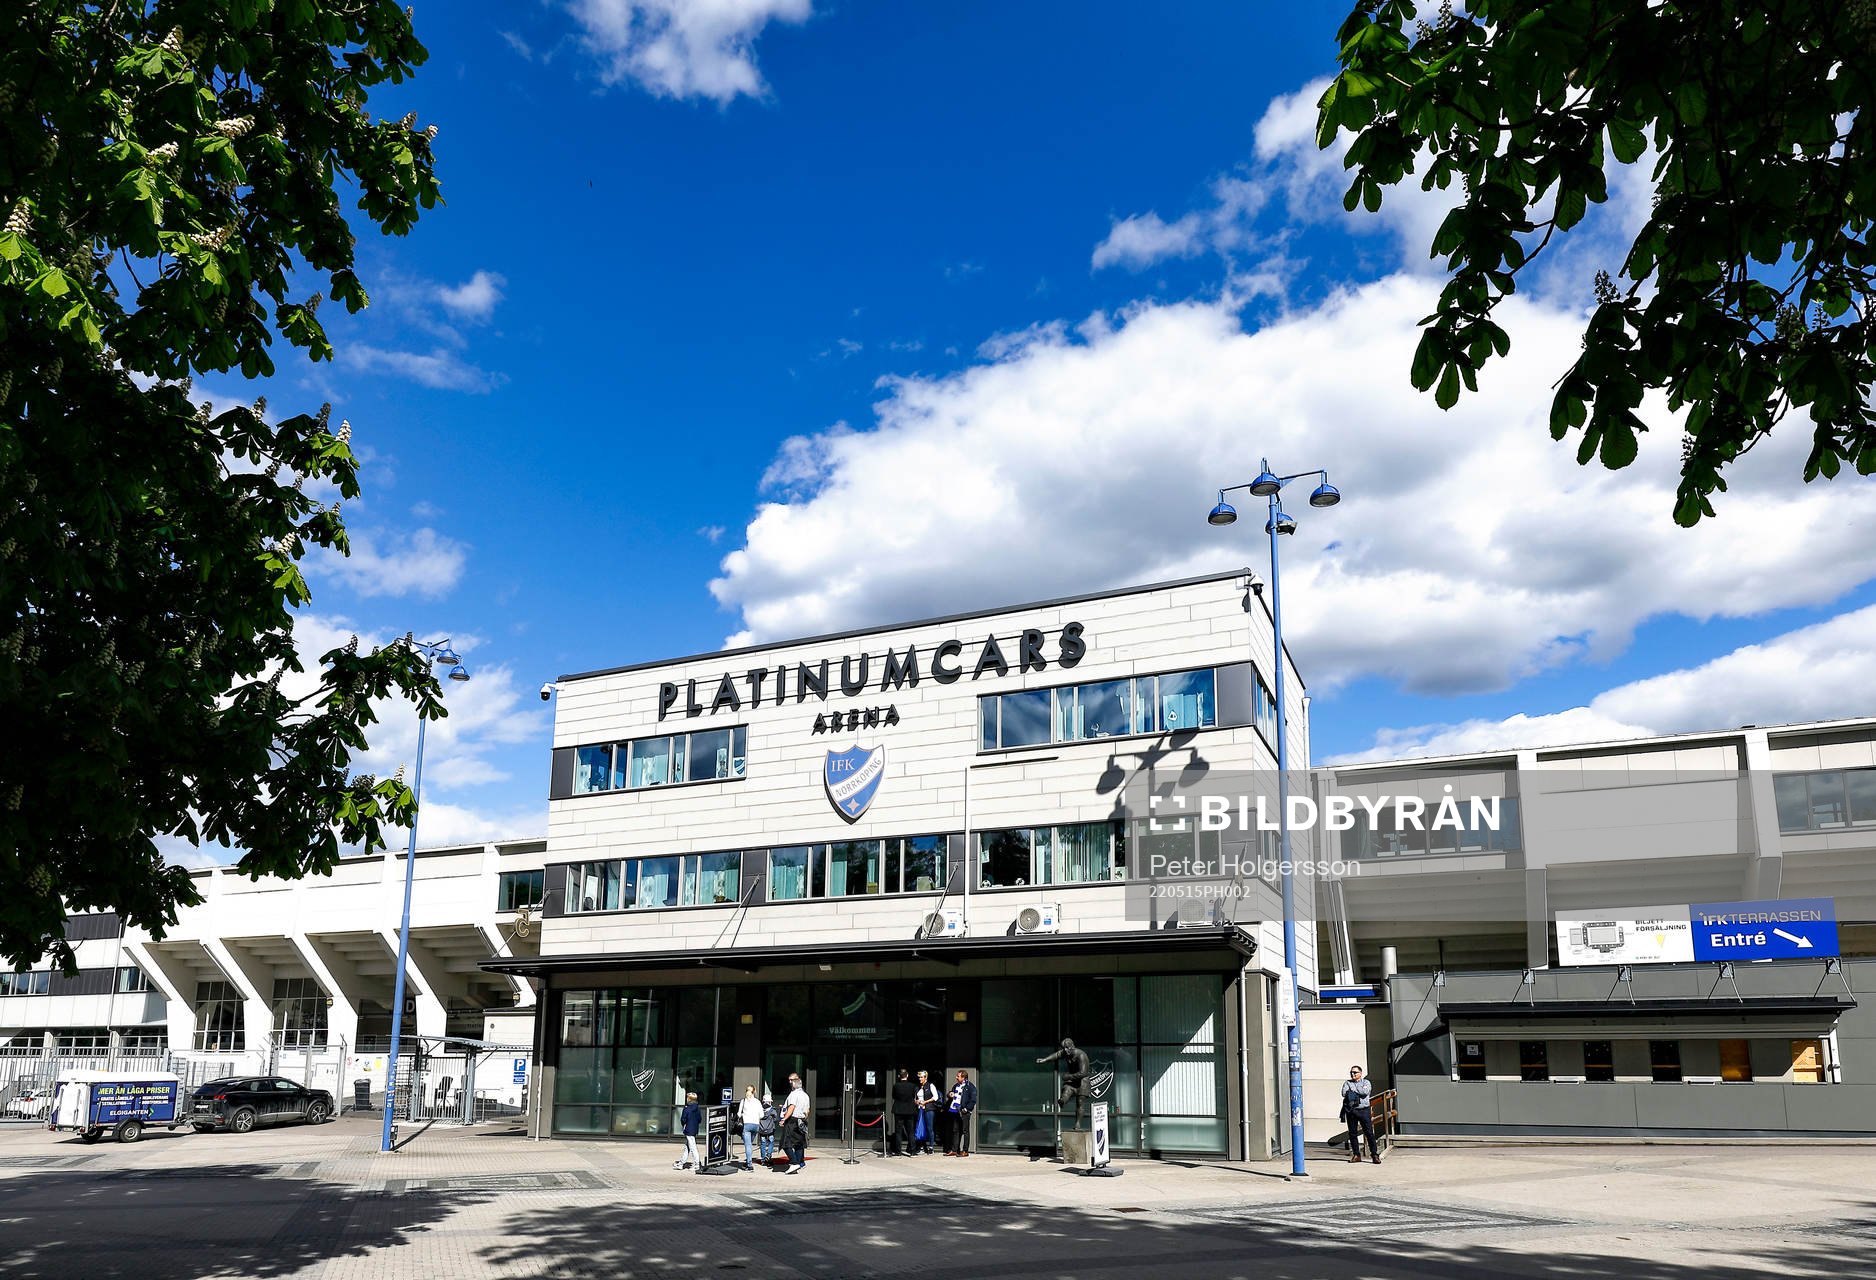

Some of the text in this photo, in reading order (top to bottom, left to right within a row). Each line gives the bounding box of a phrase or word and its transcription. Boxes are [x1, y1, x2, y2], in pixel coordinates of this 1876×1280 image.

[658, 621, 1087, 721] PLATINUMCARS
[811, 703, 900, 736] ARENA
[831, 758, 855, 772] IFK
[1710, 931, 1767, 947] Entré
[829, 1026, 877, 1034] Välkommen
[516, 1059, 525, 1071] P
[98, 1087, 114, 1095] MER
[127, 1085, 145, 1094] LÅGA
